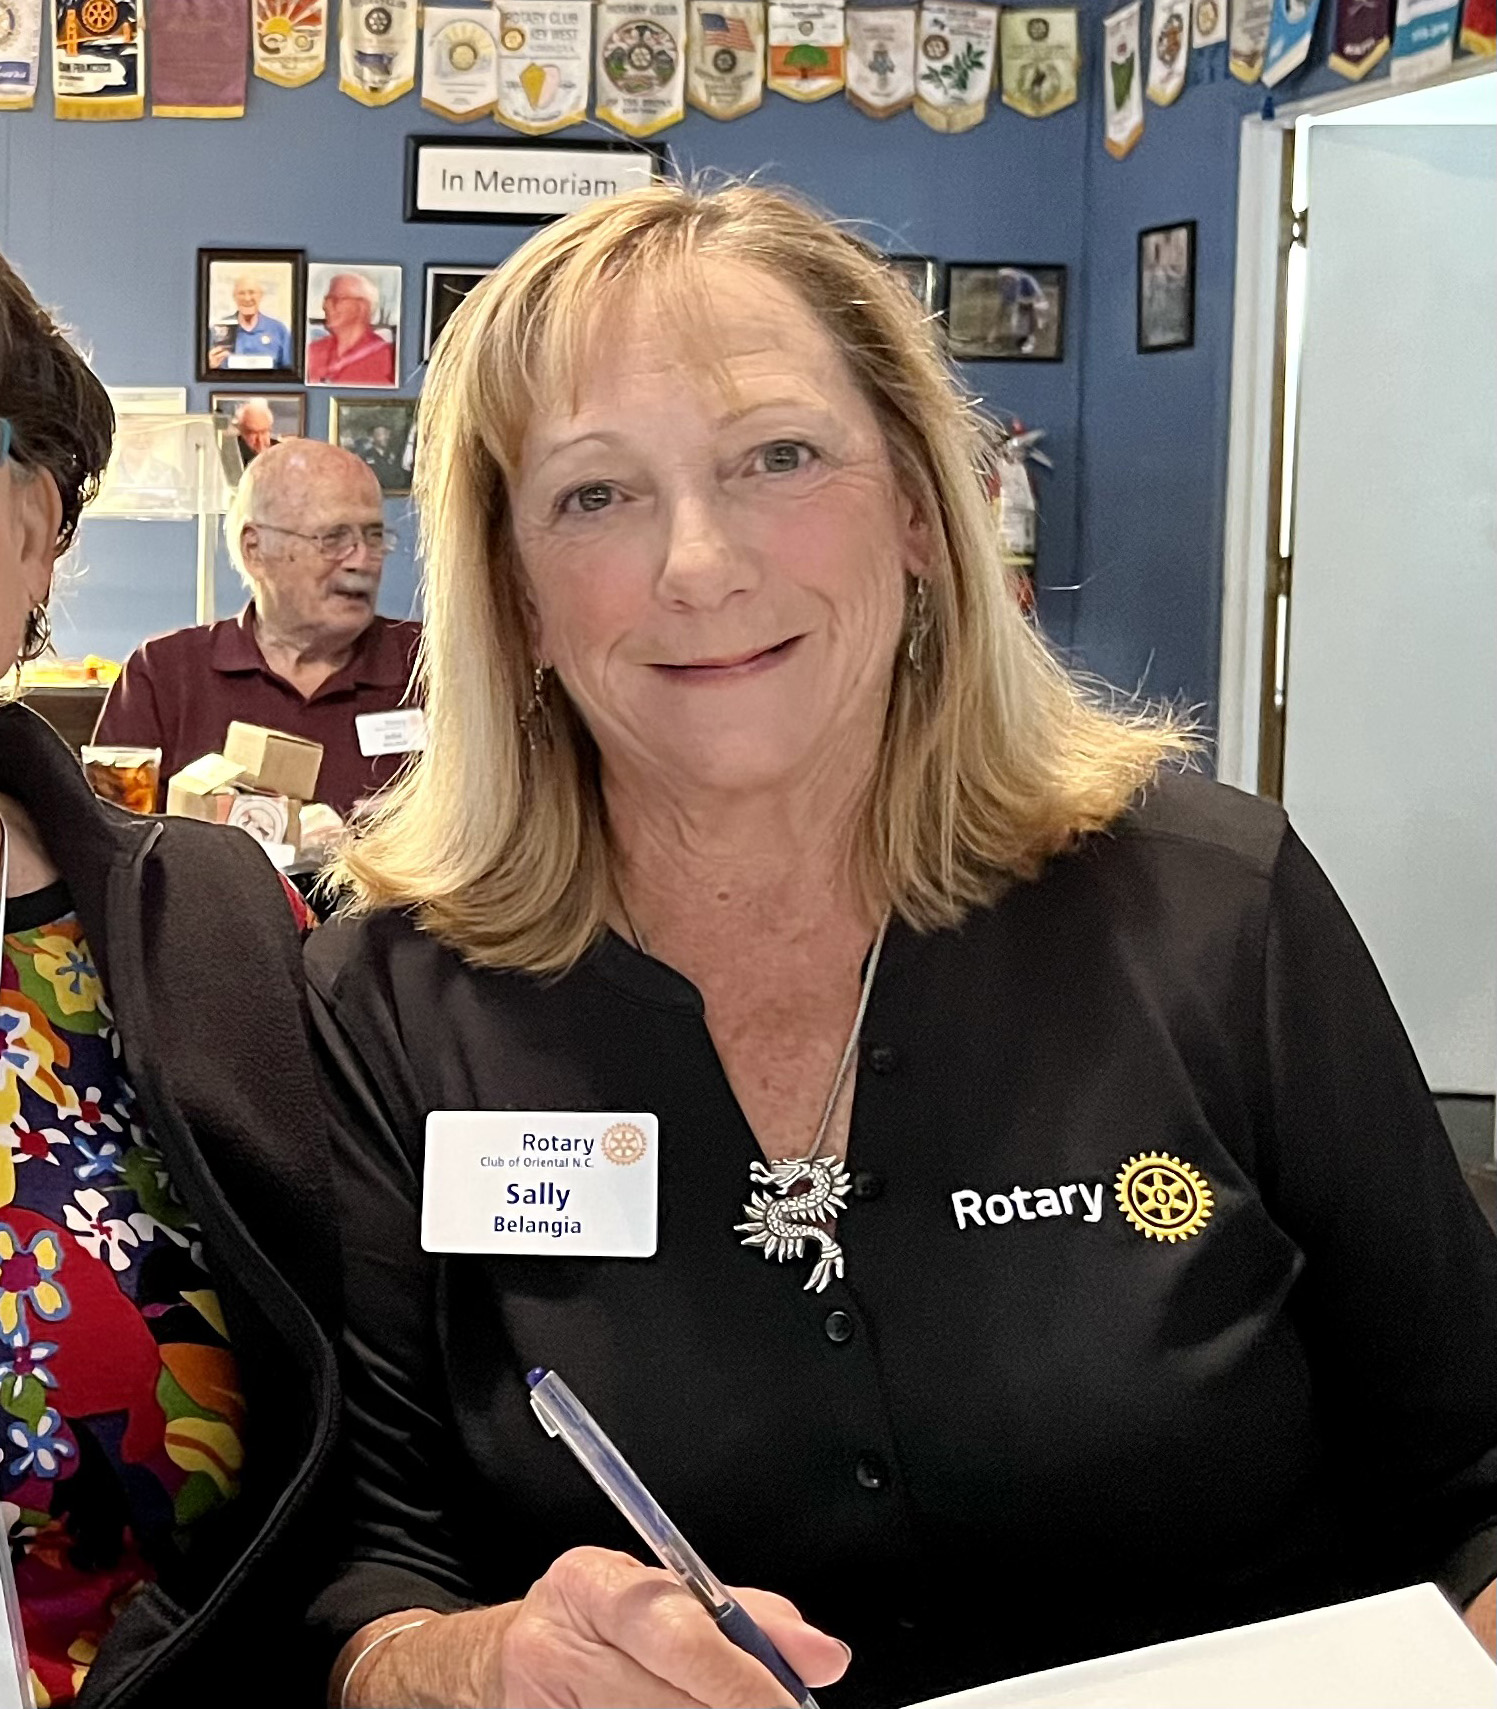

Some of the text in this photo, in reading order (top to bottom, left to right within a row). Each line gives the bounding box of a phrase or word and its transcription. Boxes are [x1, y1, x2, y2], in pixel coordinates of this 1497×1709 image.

[441, 168, 617, 197] In Memoriam
[522, 1133, 595, 1156] Rotary
[480, 1157, 505, 1168] Club
[508, 1156, 520, 1168] of
[523, 1157, 569, 1168] Oriental
[506, 1182, 571, 1212] Sally
[950, 1182, 1104, 1231] Rotary
[493, 1215, 582, 1238] Belangia
